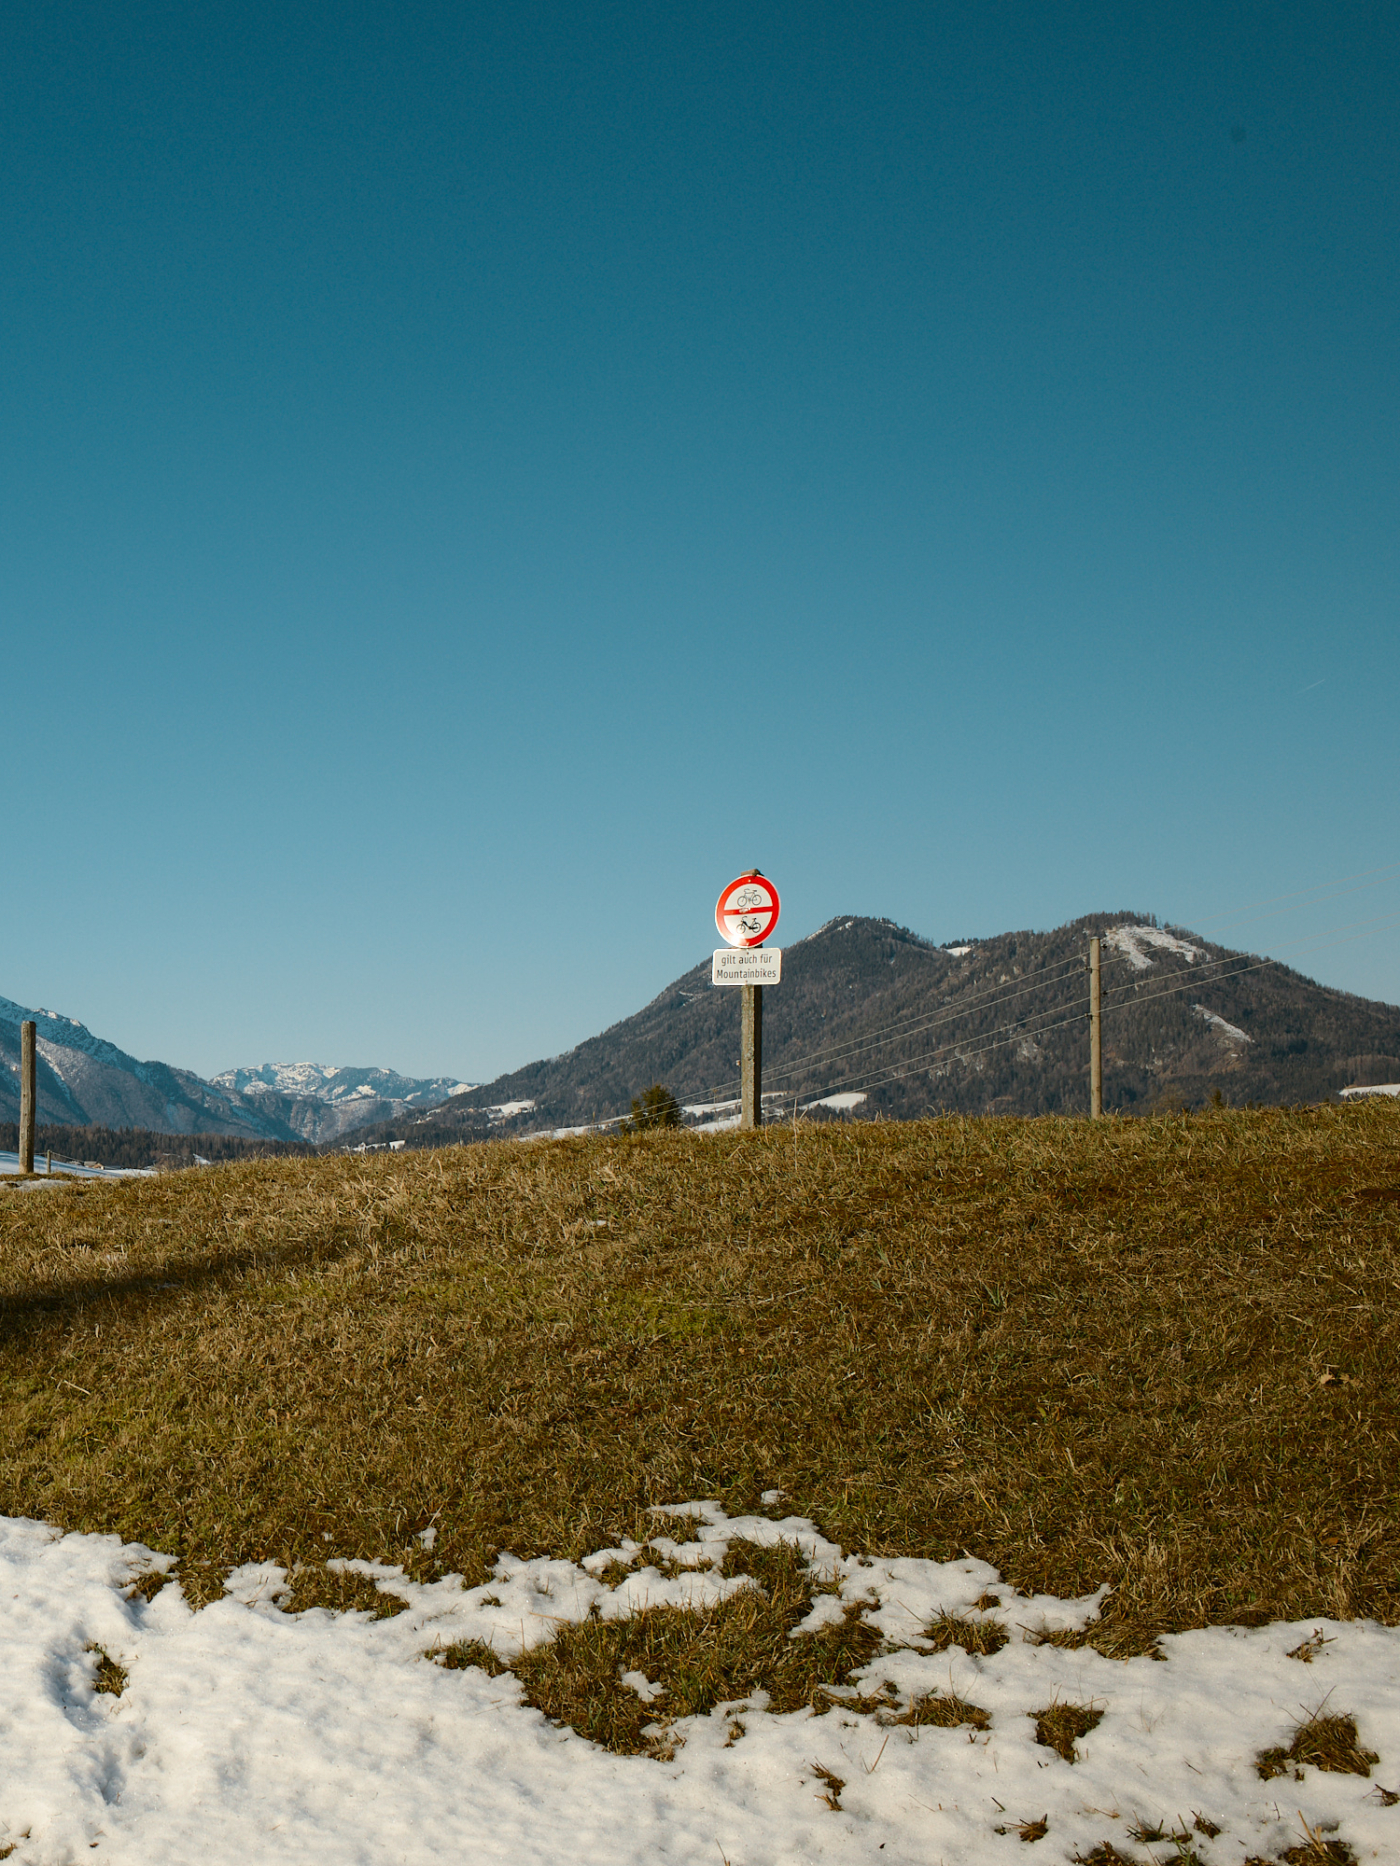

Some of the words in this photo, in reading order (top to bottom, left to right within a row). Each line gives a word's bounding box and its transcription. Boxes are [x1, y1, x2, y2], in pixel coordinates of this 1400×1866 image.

[721, 954, 736, 966] gilt
[738, 954, 757, 964] auch
[760, 953, 773, 964] für
[716, 968, 777, 978] Mountainbikes
